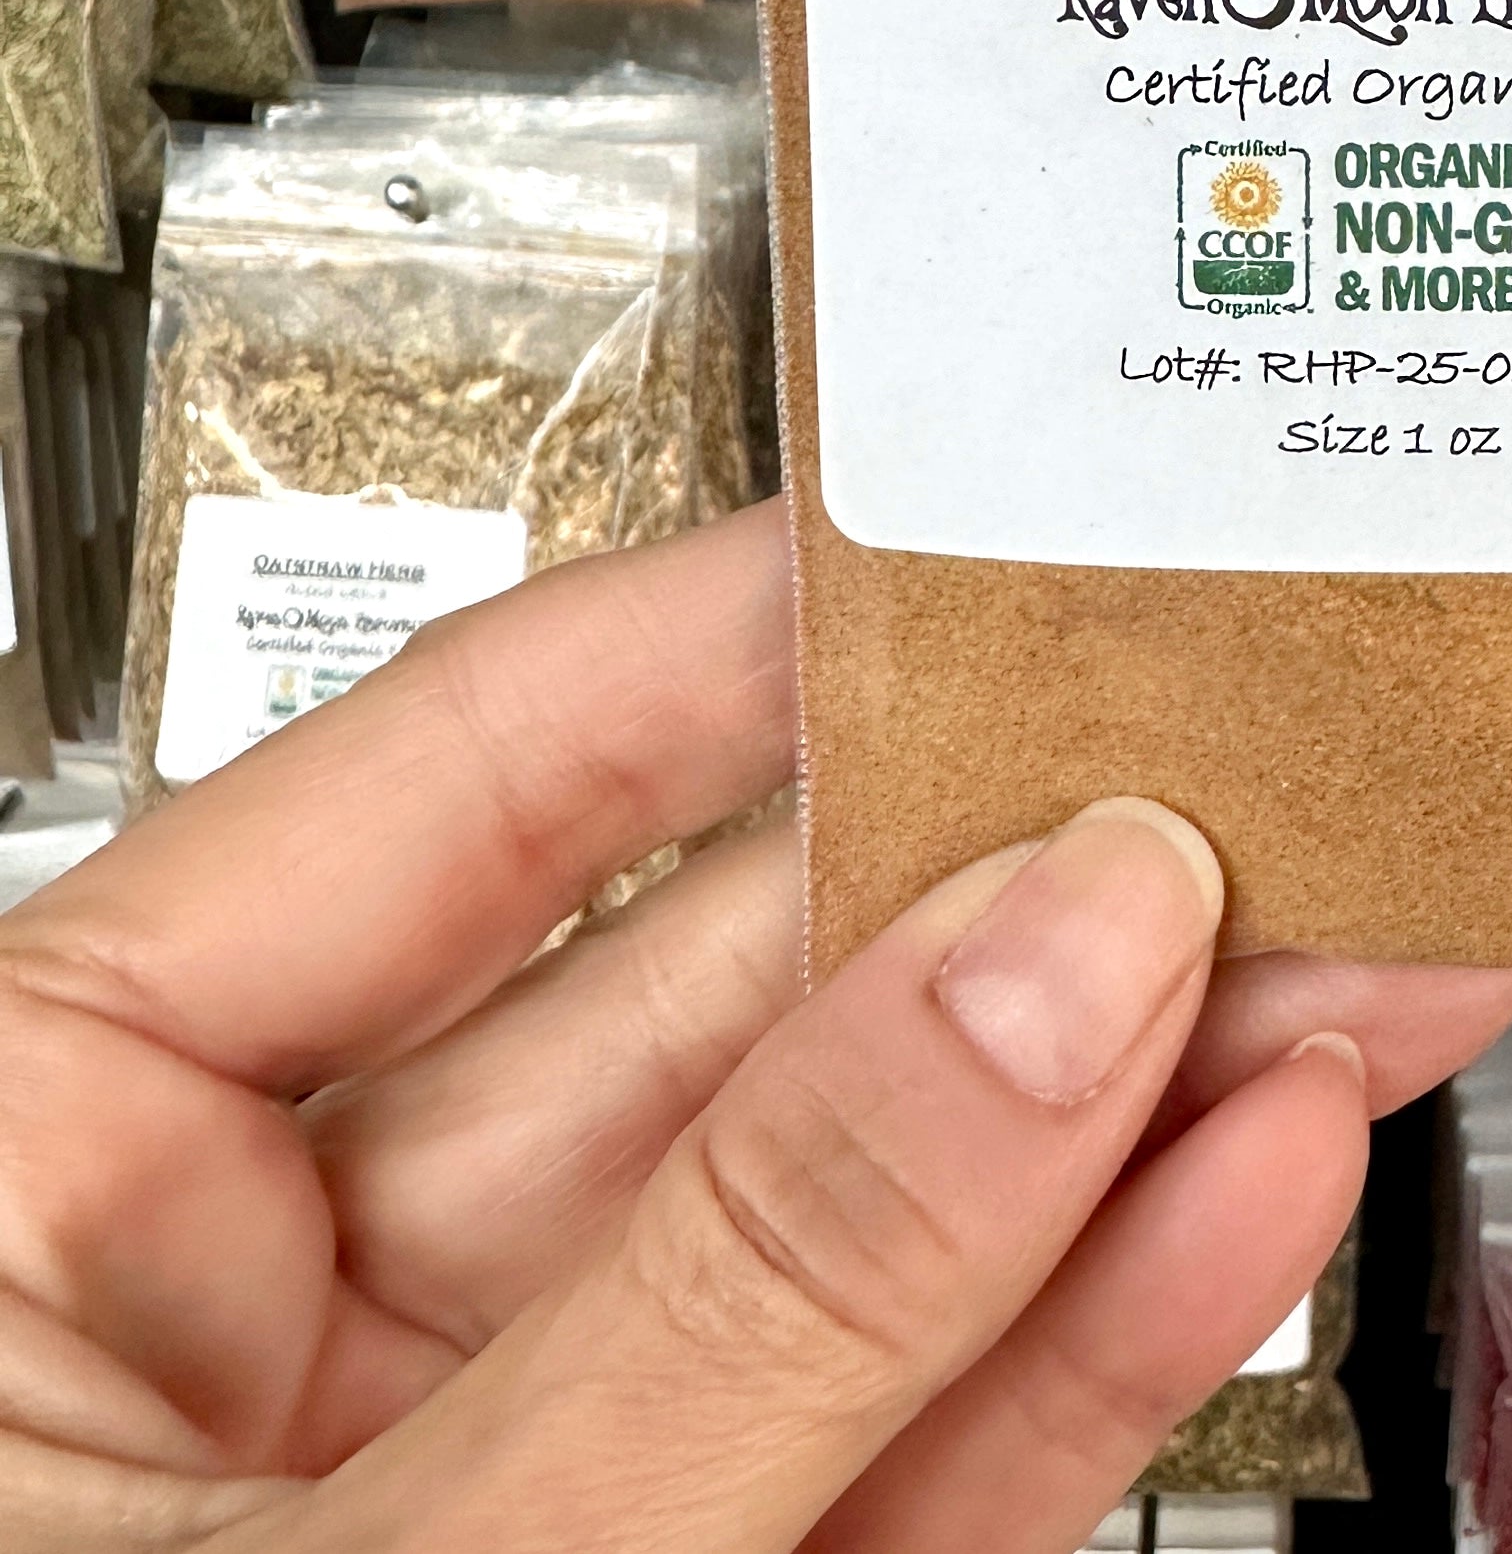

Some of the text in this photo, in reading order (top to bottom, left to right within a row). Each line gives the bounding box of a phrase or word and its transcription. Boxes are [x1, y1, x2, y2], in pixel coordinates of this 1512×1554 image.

[1105, 59, 1331, 122] Certified
[1204, 139, 1287, 158] Certified
[1198, 230, 1292, 259] CCOF
[1206, 296, 1283, 319] Organic
[1334, 269, 1371, 312] &
[1121, 346, 1241, 390] Lot#:
[1278, 413, 1502, 456] Size 1 oz
